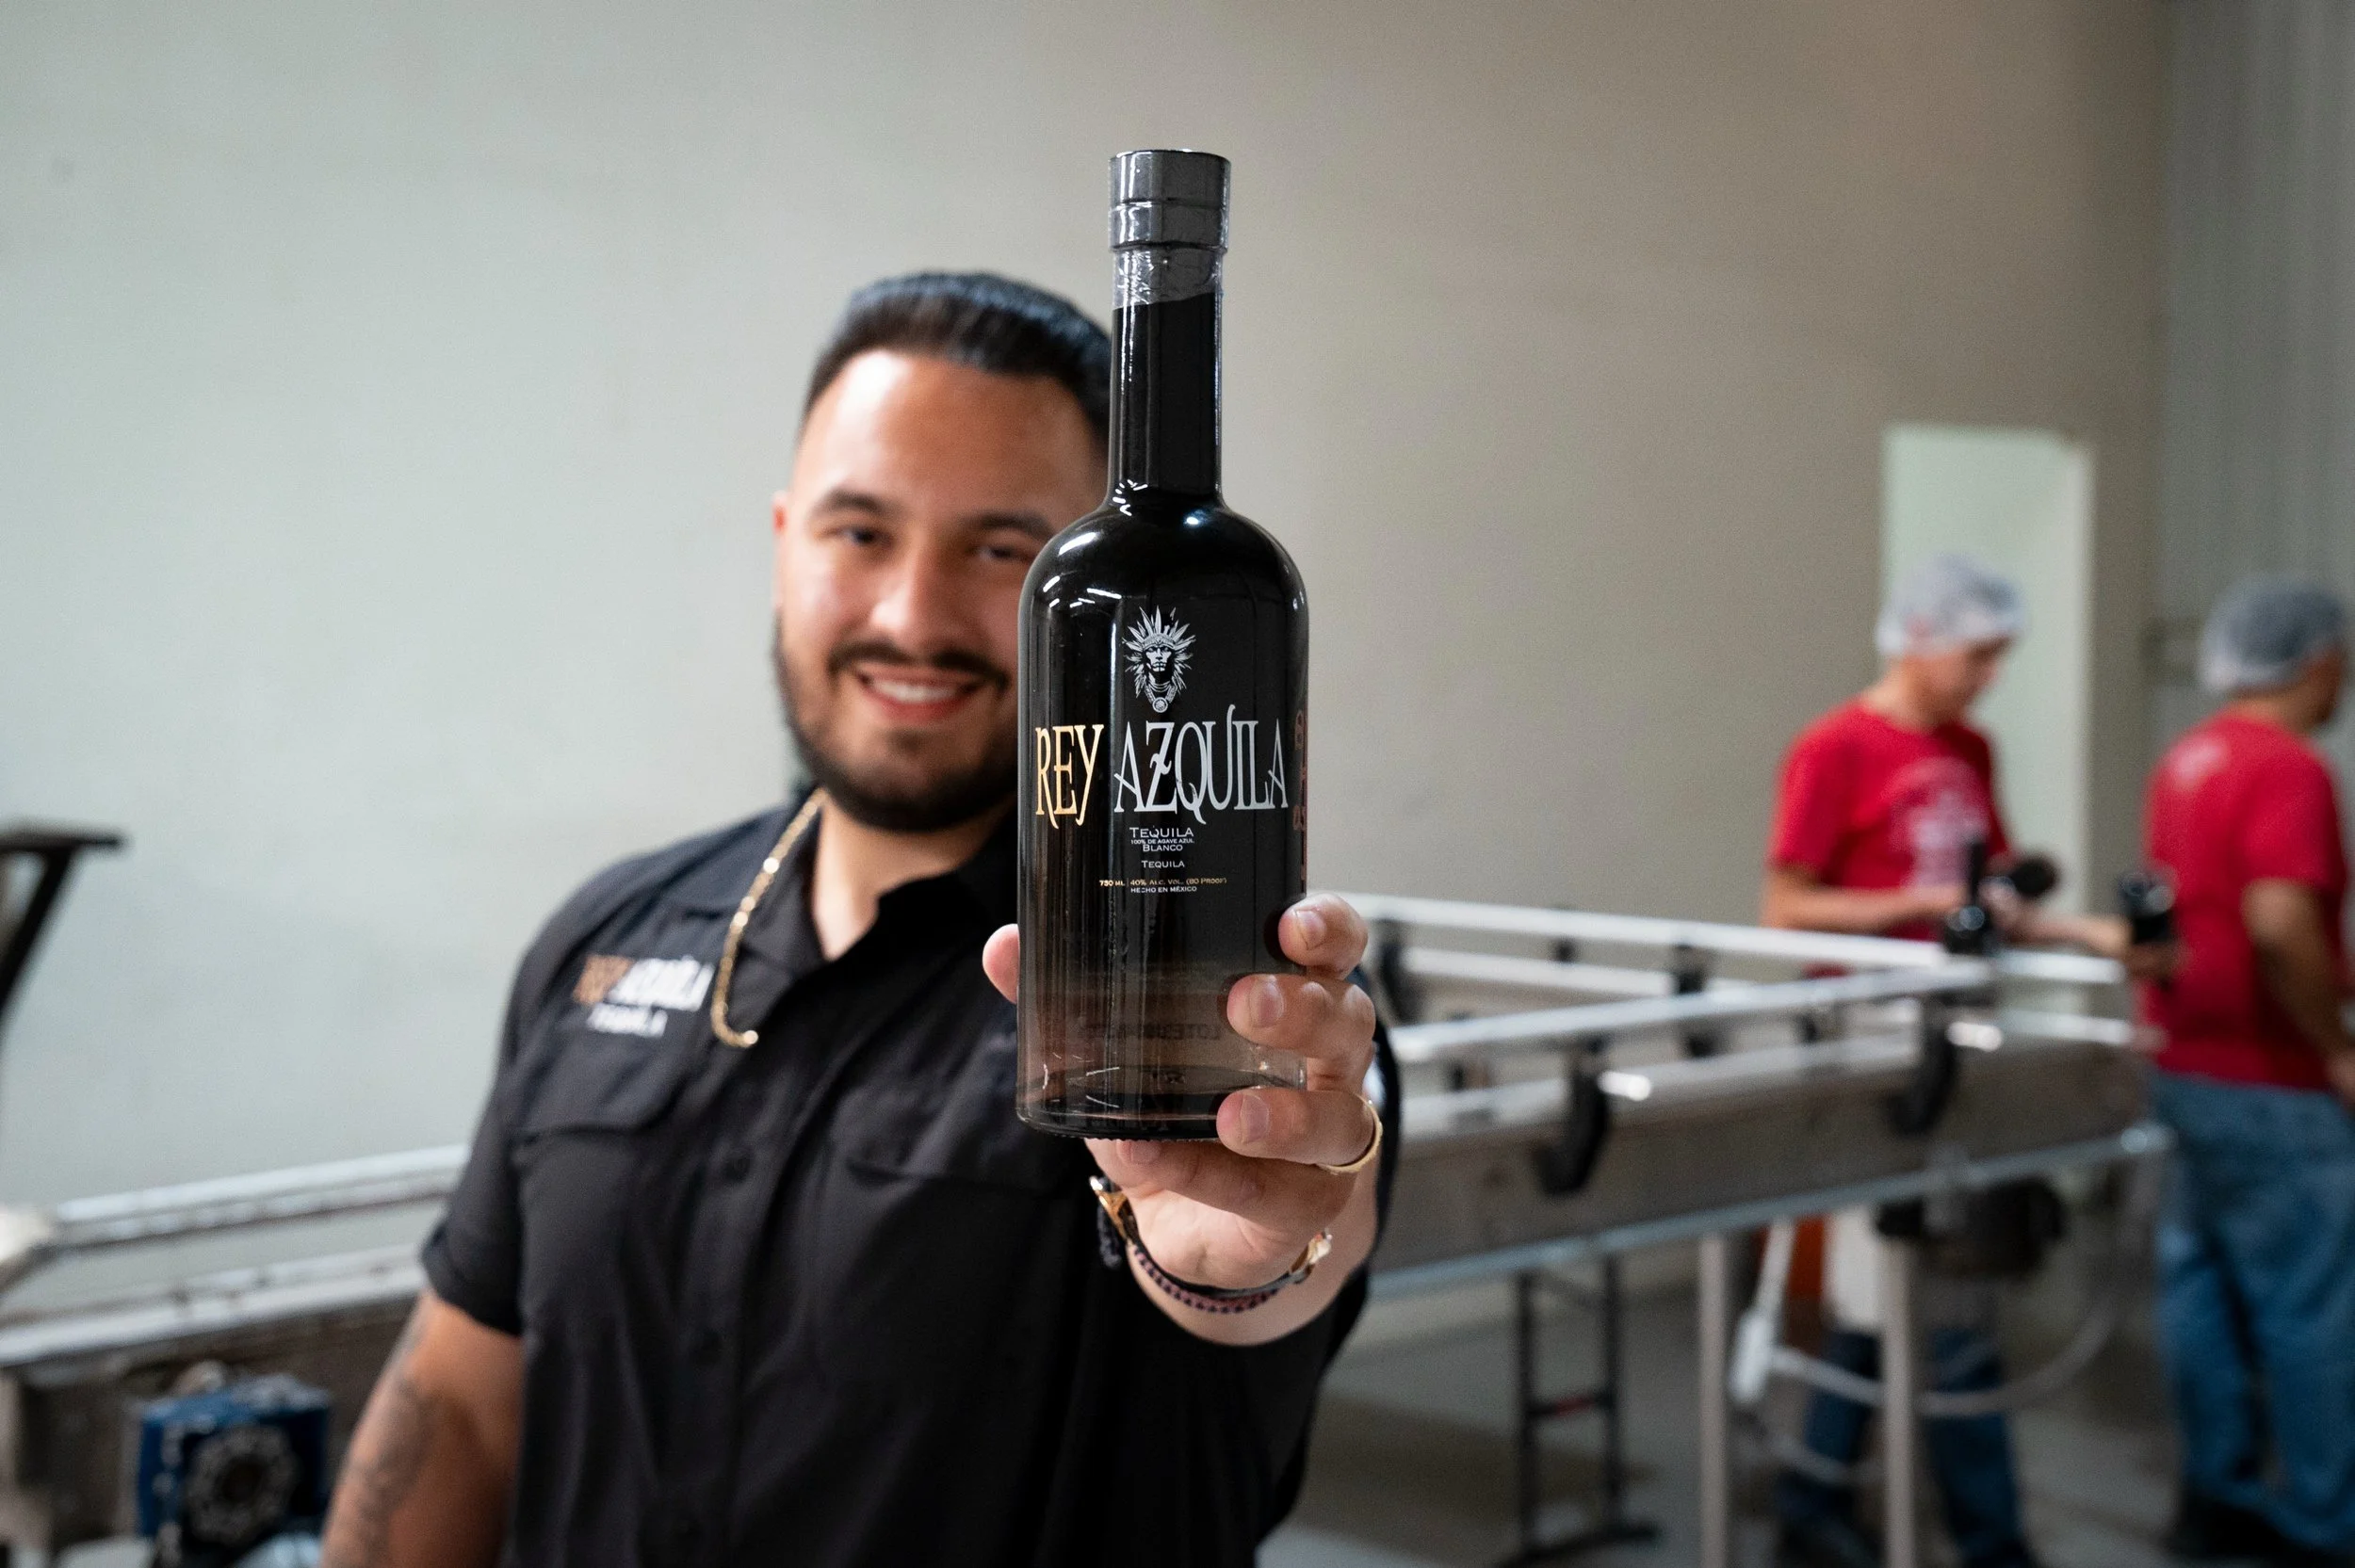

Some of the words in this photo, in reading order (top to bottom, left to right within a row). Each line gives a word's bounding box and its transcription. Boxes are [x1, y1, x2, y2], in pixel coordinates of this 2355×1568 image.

[1034, 723, 1105, 829] REY
[1129, 827, 1194, 838] TEQUILA
[1142, 844, 1184, 852] BLANCO
[1141, 860, 1185, 868] TEQUILA
[1130, 878, 1147, 886] 40%
